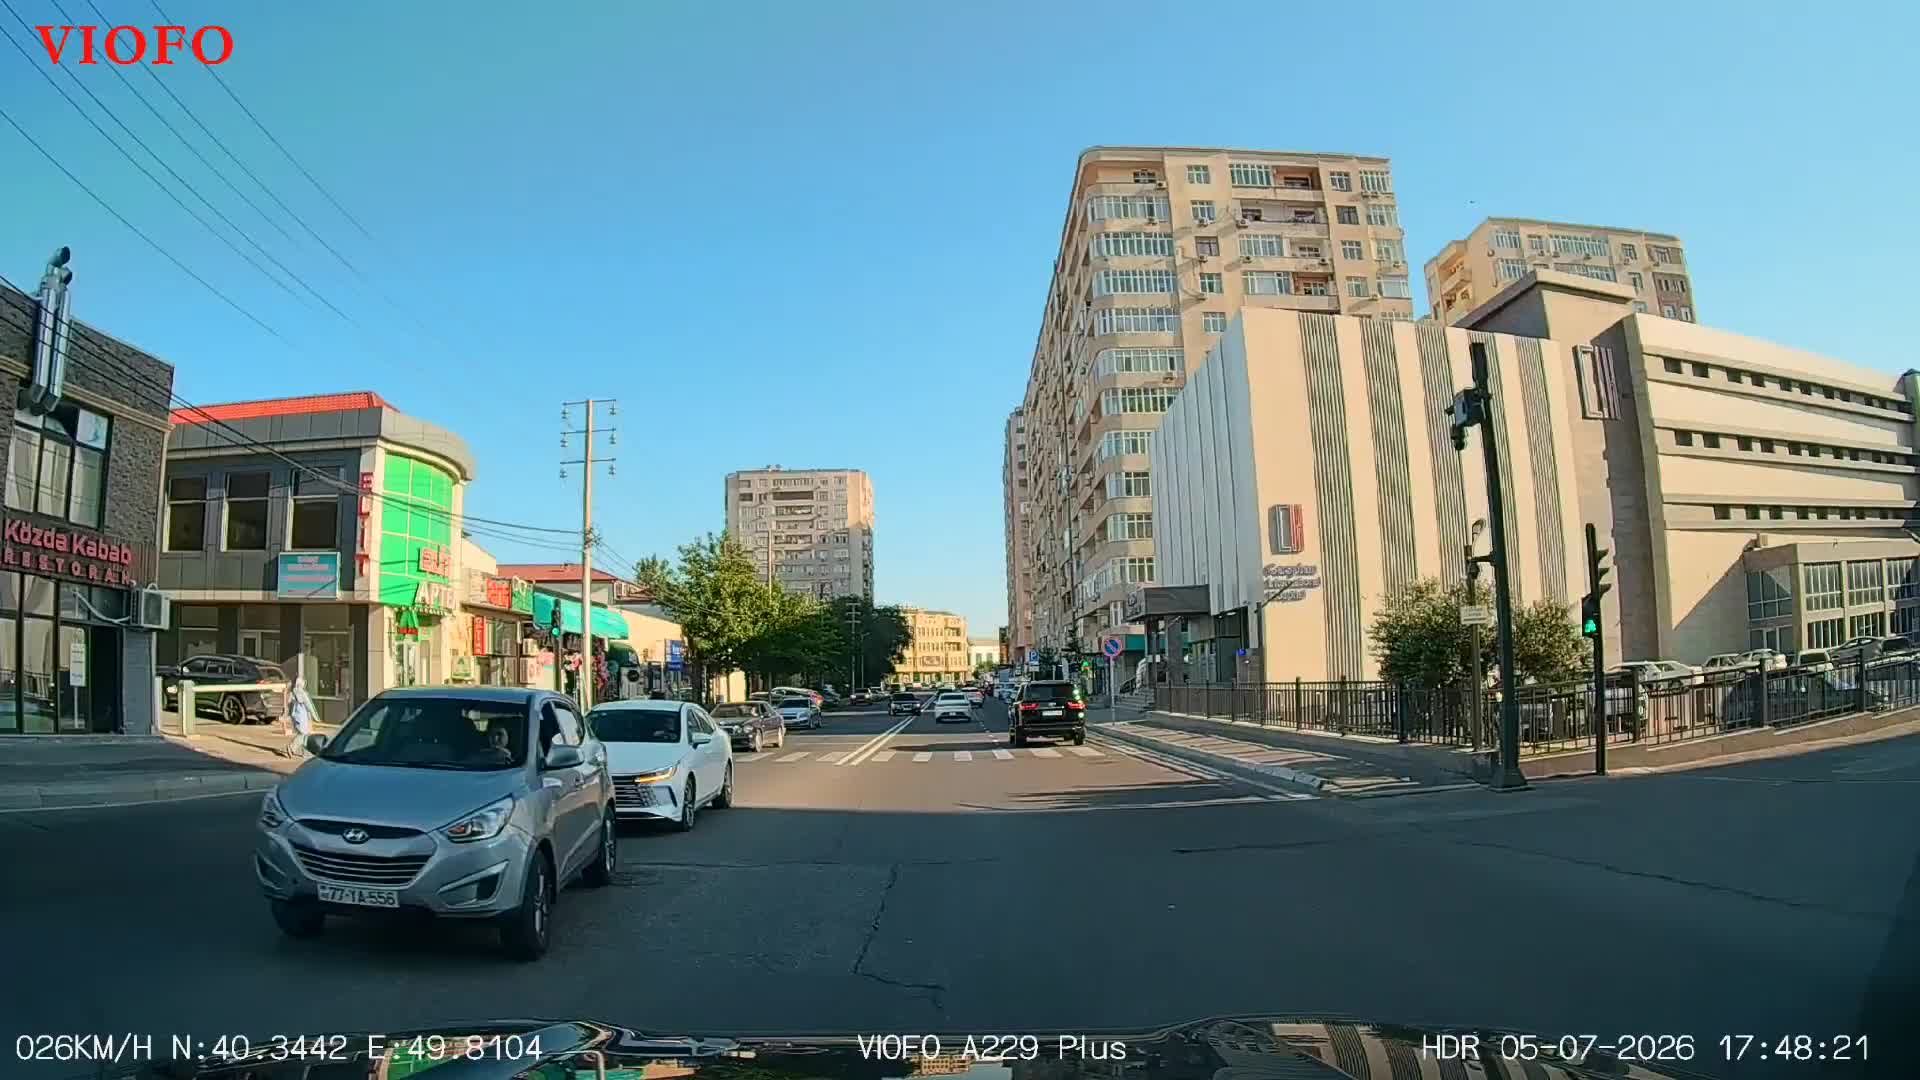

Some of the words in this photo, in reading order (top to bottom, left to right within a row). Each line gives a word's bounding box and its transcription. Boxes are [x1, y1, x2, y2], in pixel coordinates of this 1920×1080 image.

[5, 518, 68, 552] Közda
[71, 532, 132, 565] Kabab
[4, 547, 130, 585] RESTORAN
